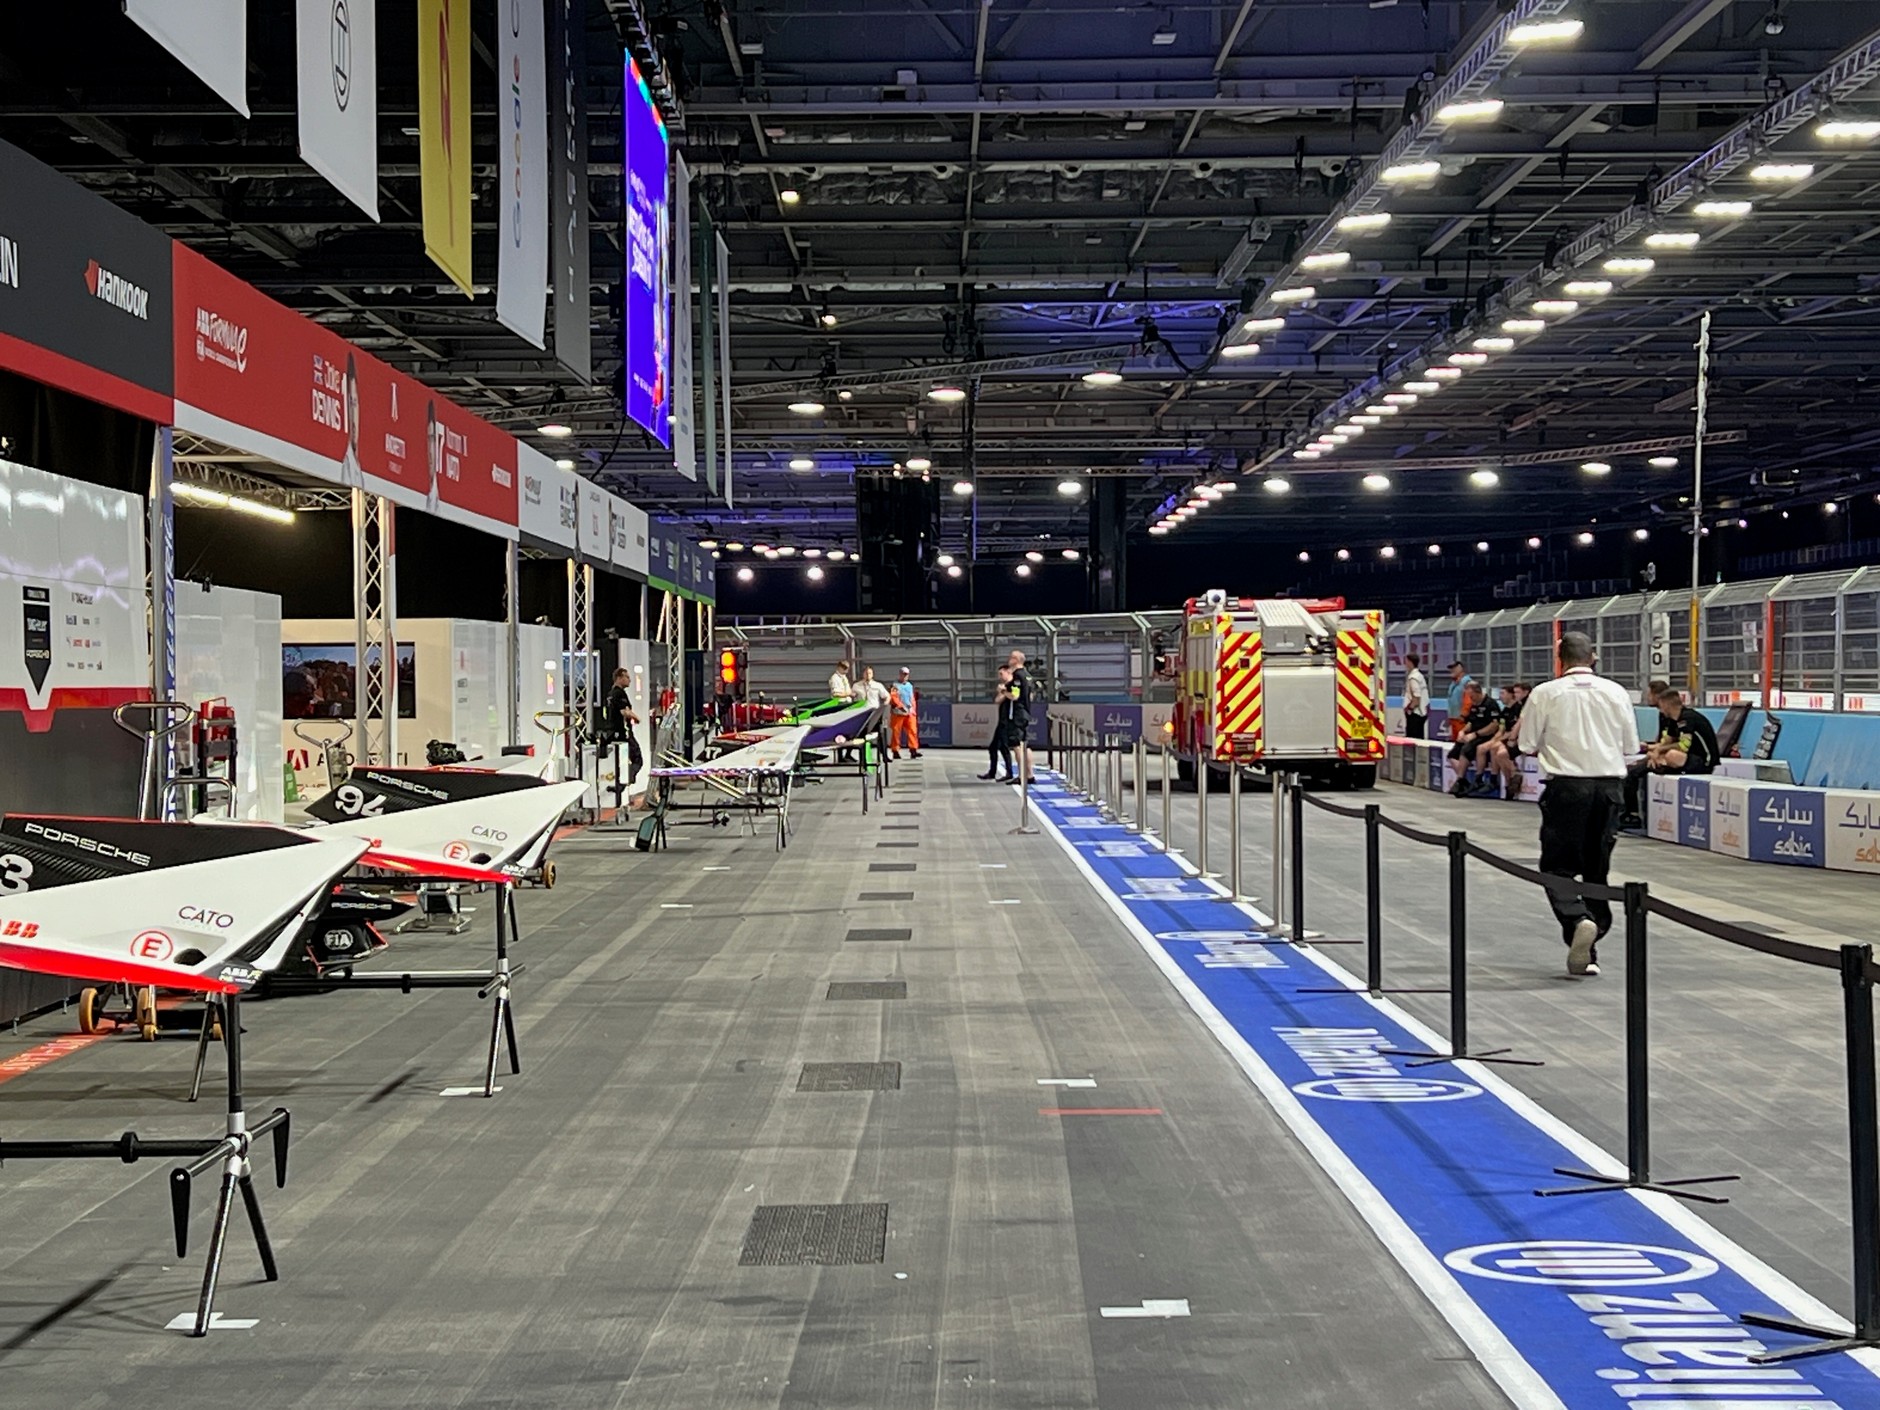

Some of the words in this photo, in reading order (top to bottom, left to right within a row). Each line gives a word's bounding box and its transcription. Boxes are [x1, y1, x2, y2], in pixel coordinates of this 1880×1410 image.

[512, 54, 521, 249] Google
[0, 236, 18, 289] IN
[366, 771, 449, 801] PORSCHE
[334, 785, 387, 818] 94
[24, 822, 152, 867] PORSCHE
[471, 825, 508, 842] CATO
[178, 905, 234, 928] CATO
[331, 902, 392, 910] PORSCHE
[0, 919, 40, 939] BB
[325, 933, 350, 947] FIA
[141, 937, 164, 957] E
[1270, 1026, 1402, 1077] Allianz
[1567, 1292, 1845, 1410] llianz
